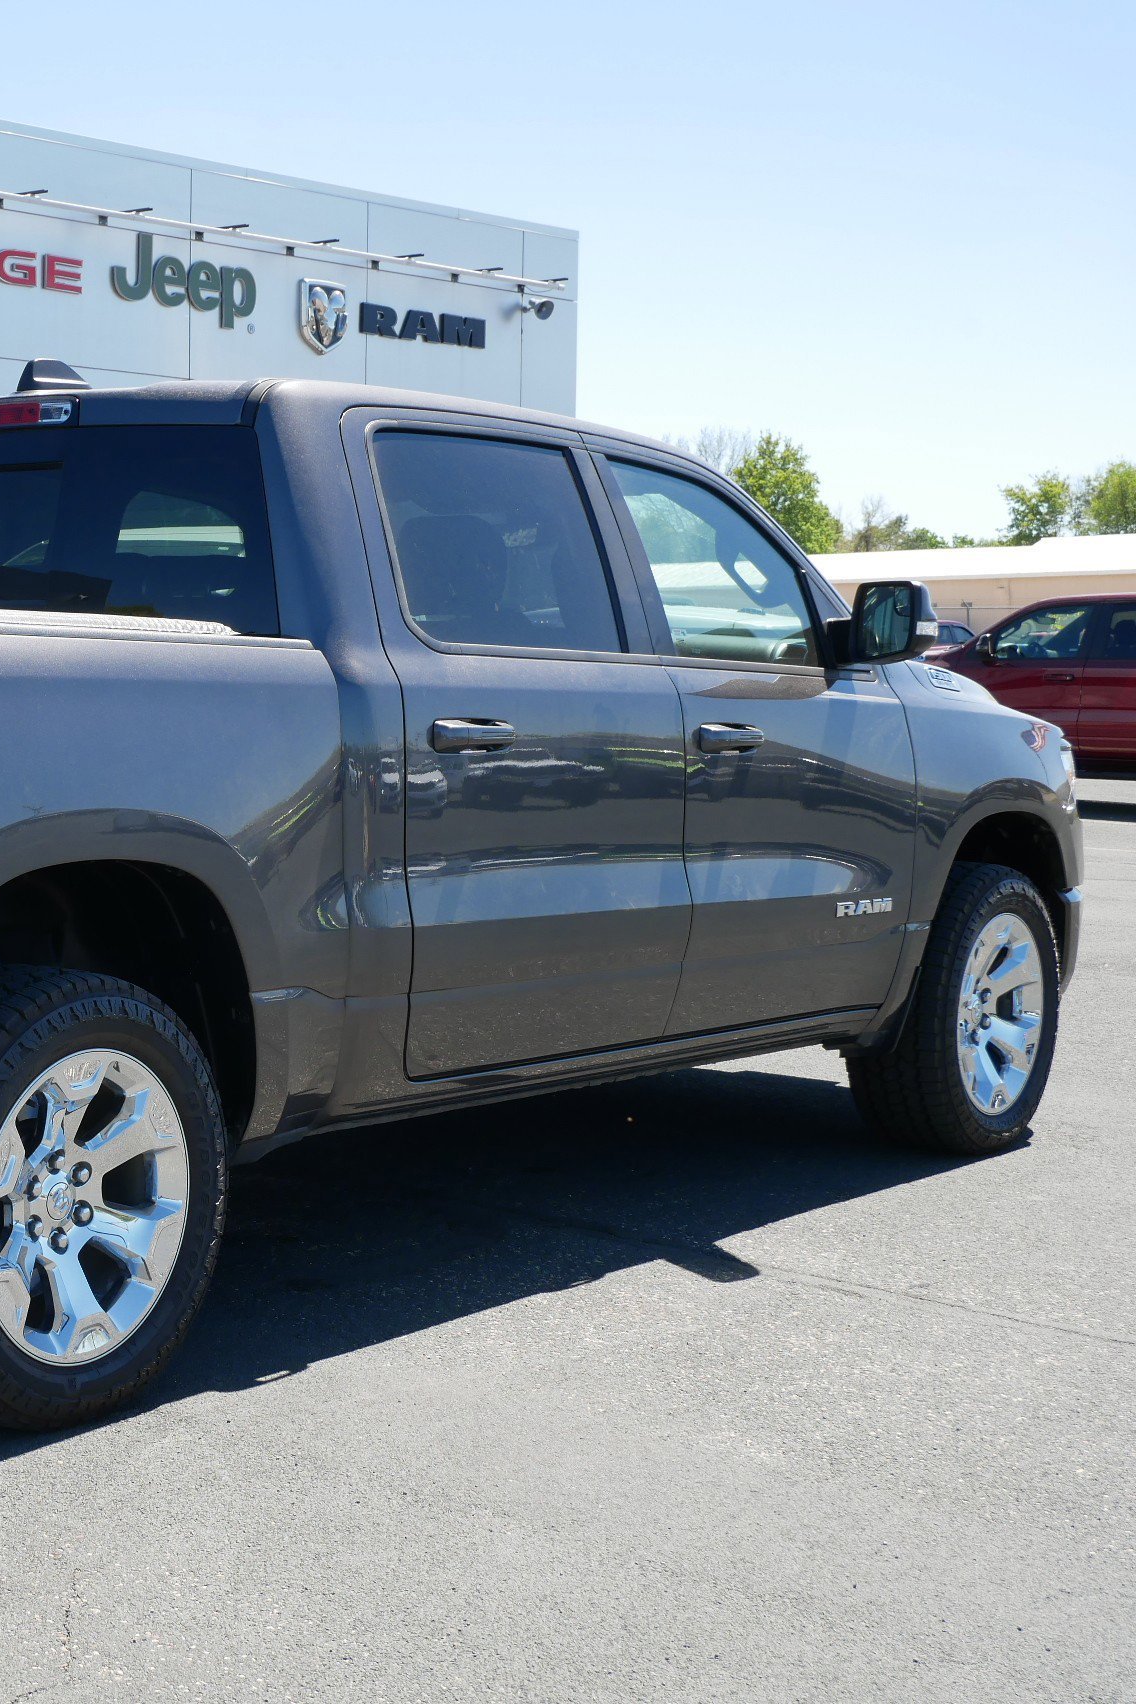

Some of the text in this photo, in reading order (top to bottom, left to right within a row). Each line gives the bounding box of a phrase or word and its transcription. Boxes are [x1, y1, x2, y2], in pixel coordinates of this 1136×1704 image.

[111, 232, 257, 330] Jeep
[359, 302, 486, 349] RAM
[836, 897, 893, 917] RAM
